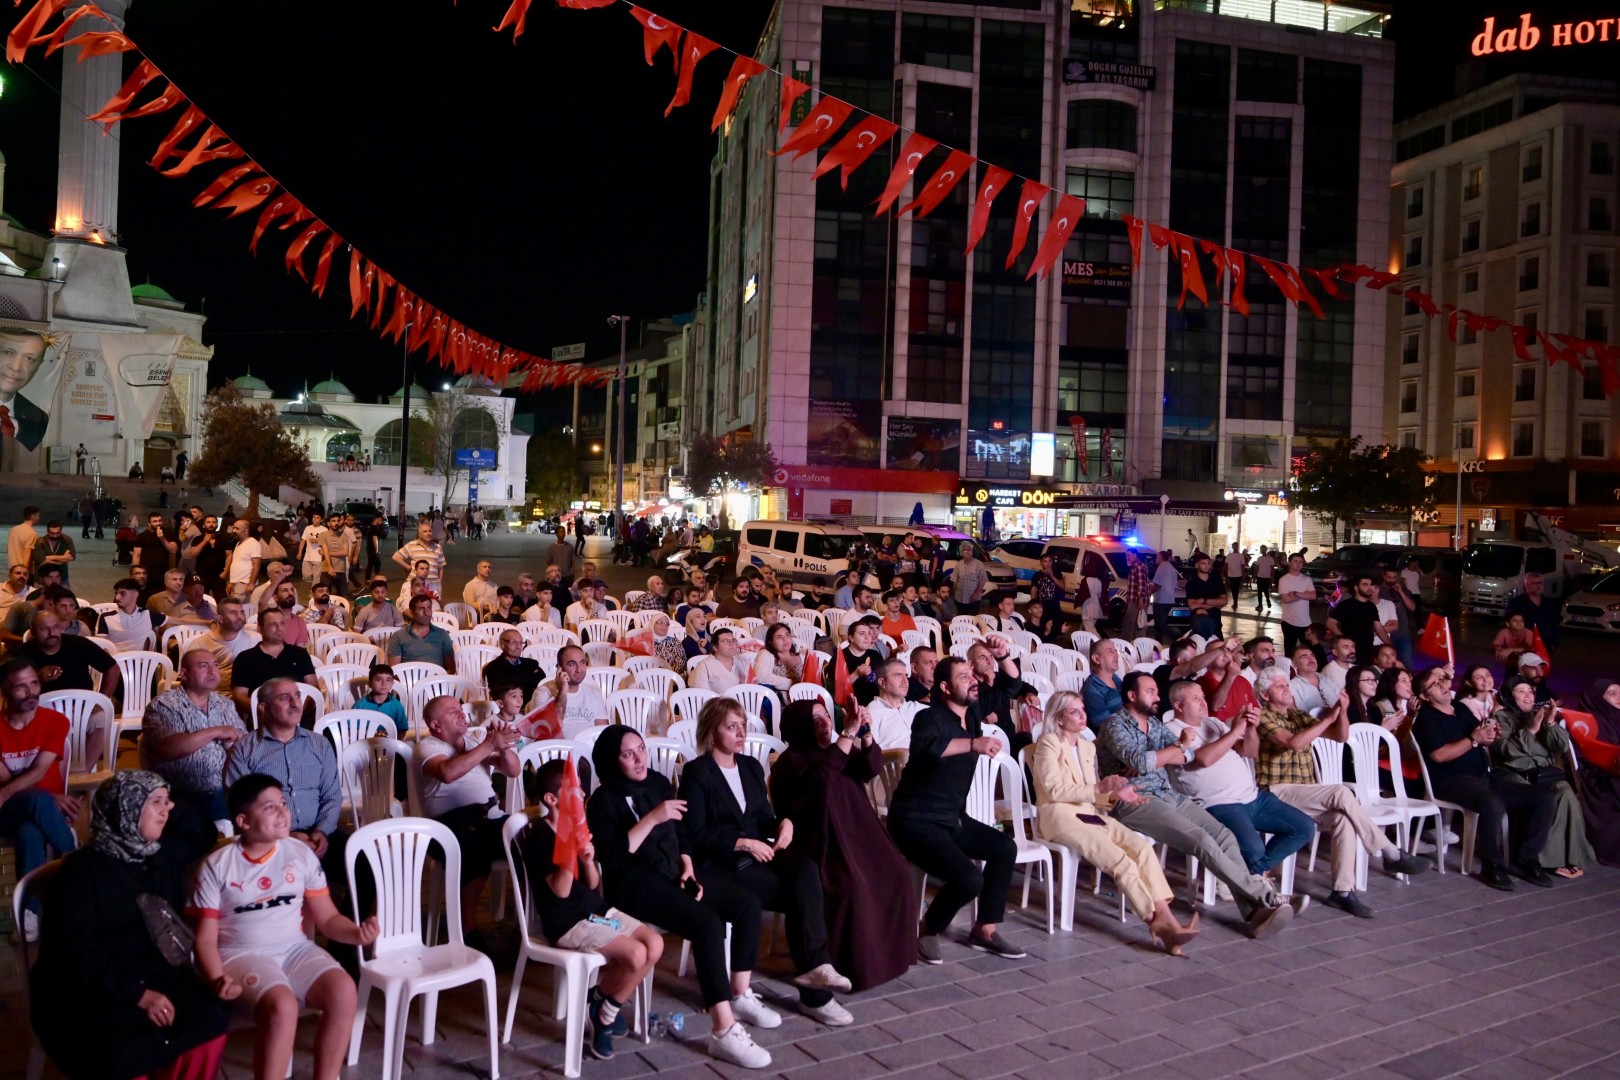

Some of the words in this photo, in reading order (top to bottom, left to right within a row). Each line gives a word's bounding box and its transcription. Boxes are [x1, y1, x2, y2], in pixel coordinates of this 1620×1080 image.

[1471, 13, 1540, 56] dab
[1064, 262, 1094, 276] MES
[890, 422, 901, 430] Her
[1461, 460, 1485, 473] KFC
[790, 473, 831, 483] vodafone
[989, 489, 1021, 498] HAREKET
[995, 497, 1015, 505] CAFE
[804, 562, 828, 573] POLİS
[2, 751, 19, 759] NEW
